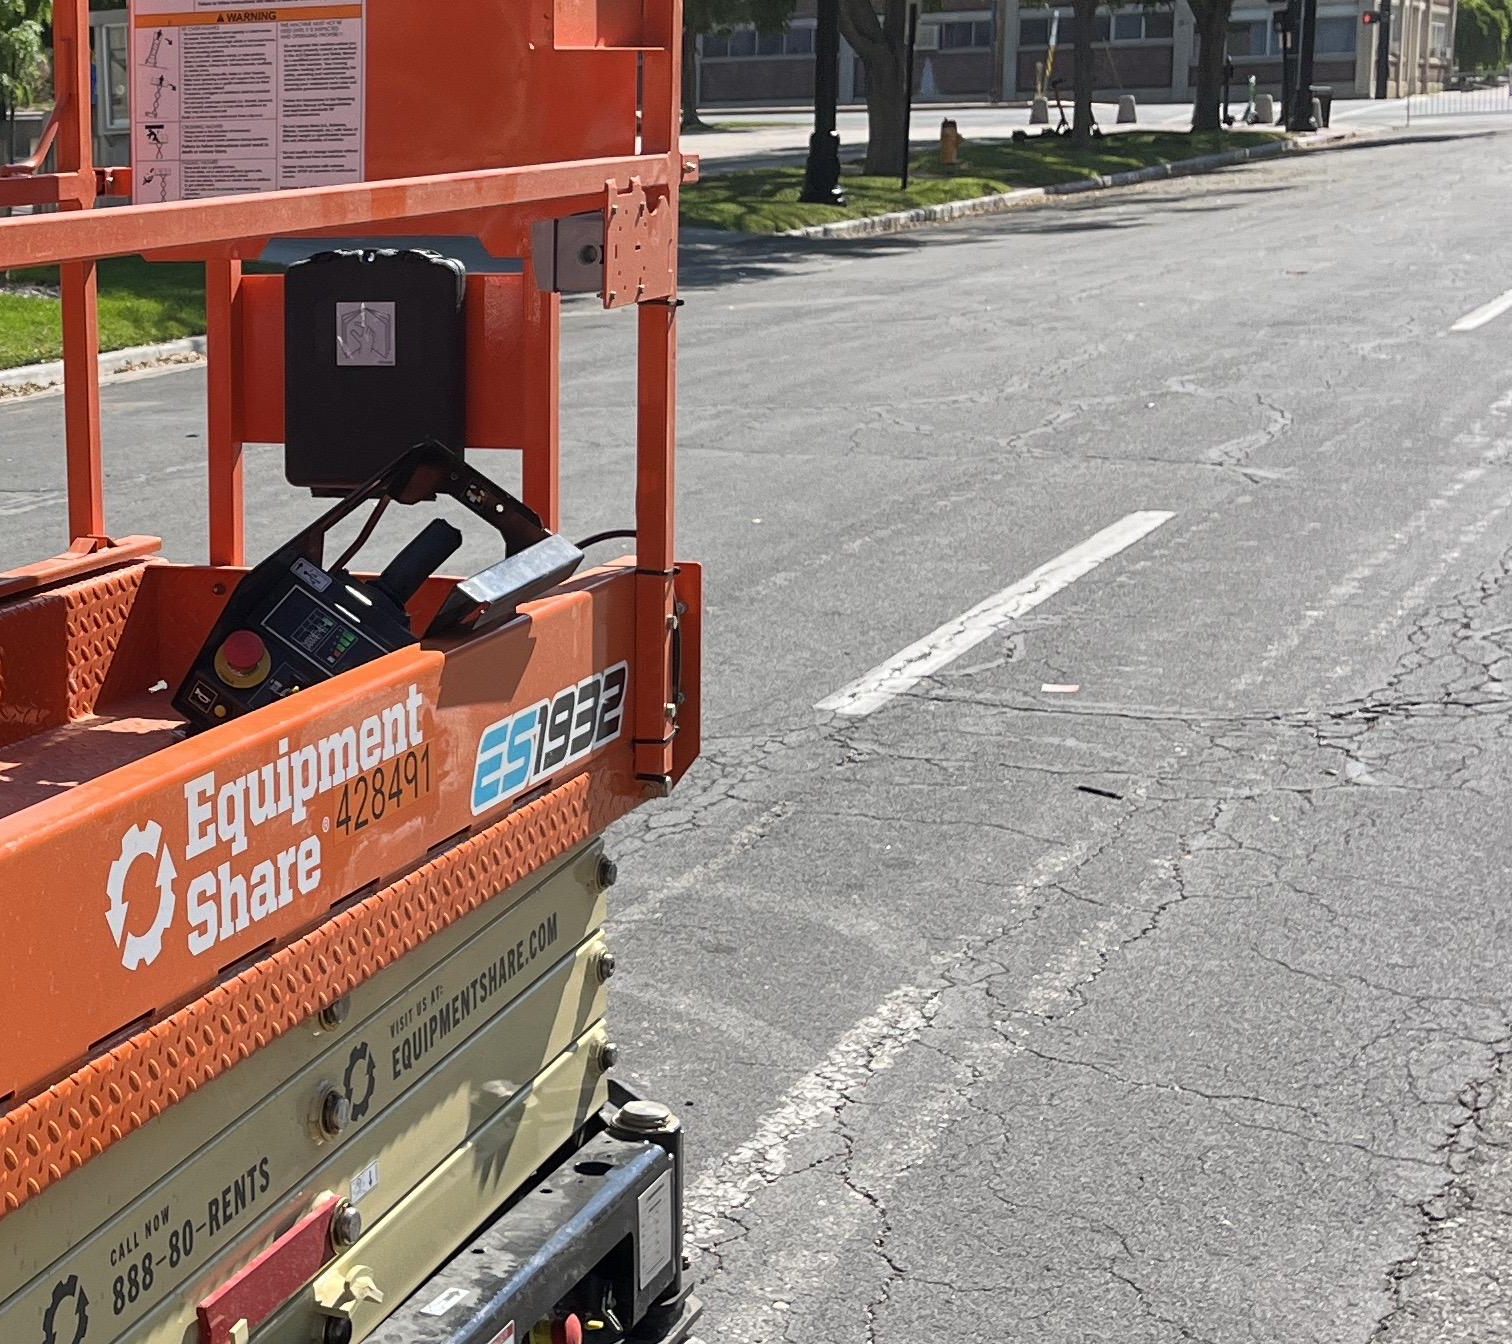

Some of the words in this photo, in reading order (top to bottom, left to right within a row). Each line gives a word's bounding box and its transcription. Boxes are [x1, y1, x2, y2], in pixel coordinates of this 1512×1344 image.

[227, 11, 277, 23] WARNING
[184, 683, 424, 860] Equipment
[336, 743, 430, 836] 428491
[471, 660, 628, 816] ES1932
[187, 834, 321, 956] Share
[390, 1007, 413, 1038] VISIT
[416, 996, 427, 1017] US
[391, 911, 558, 1080] EQUIPMENTSHARE.COM
[110, 1231, 140, 1267] CALL
[145, 1205, 170, 1239] NOW
[113, 1157, 270, 1316] 888-80-RENTS
